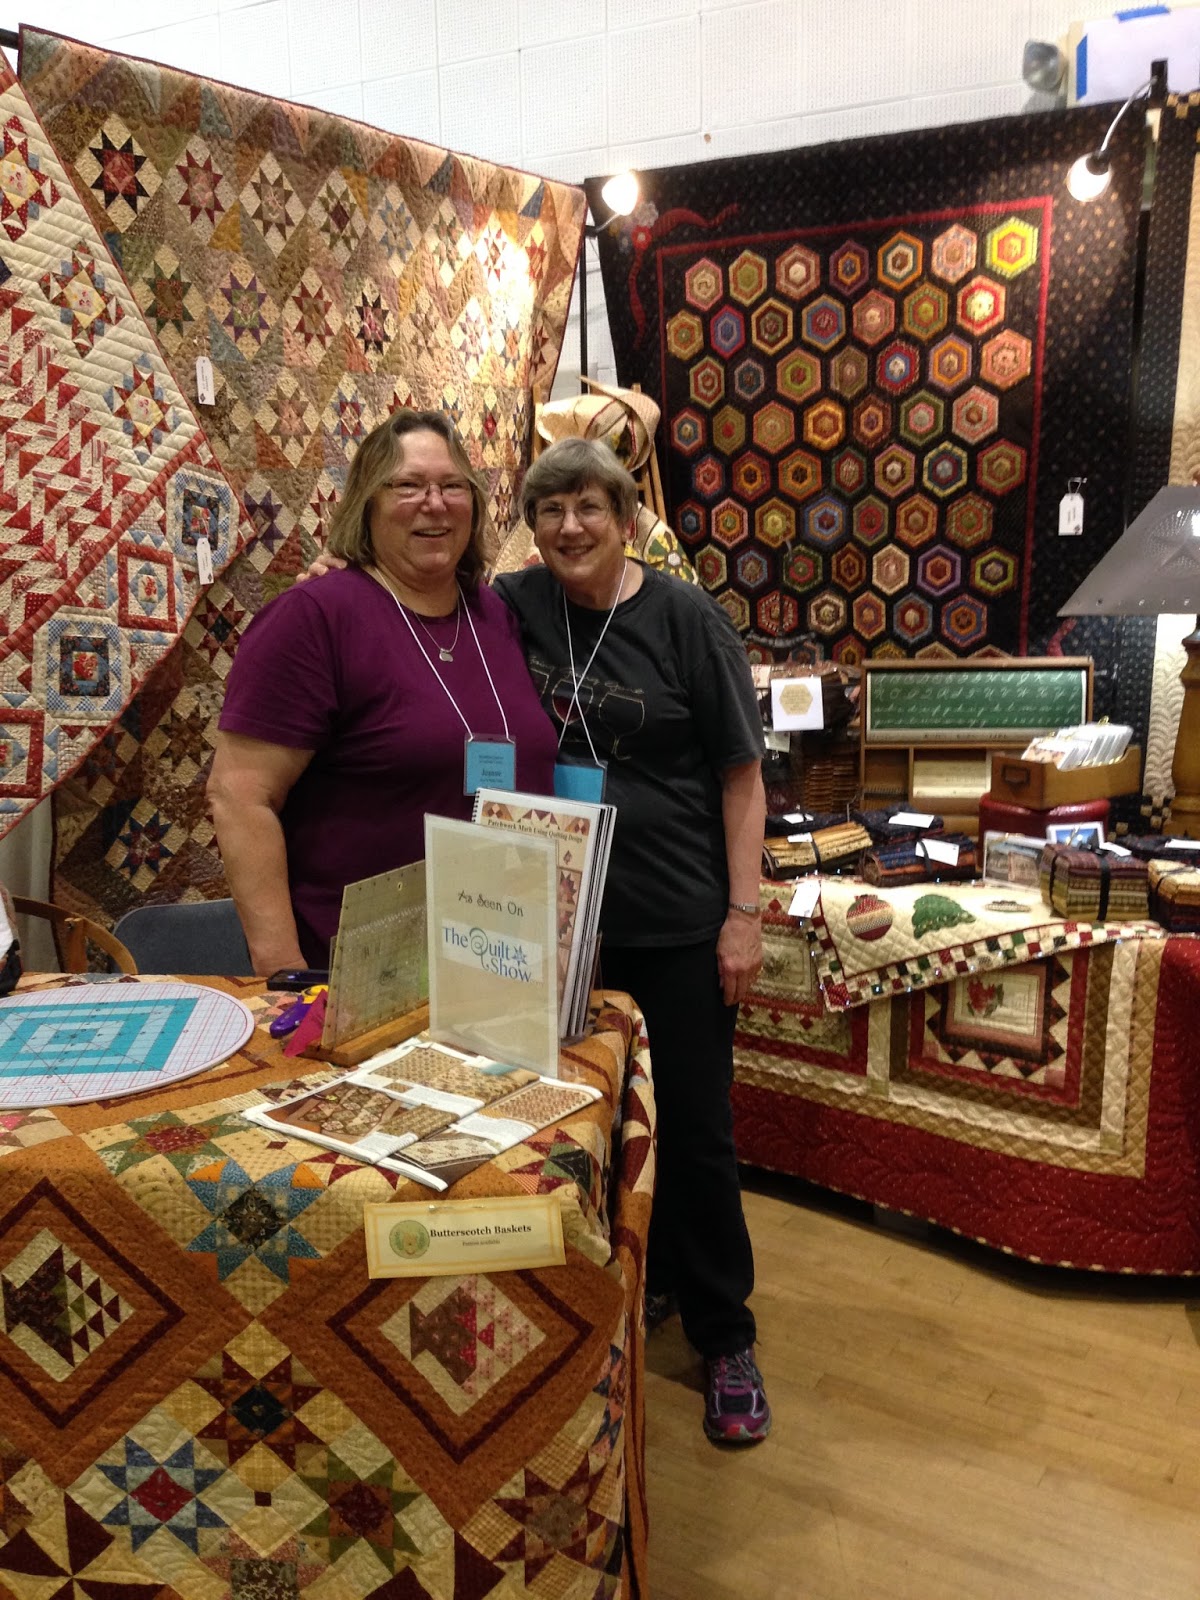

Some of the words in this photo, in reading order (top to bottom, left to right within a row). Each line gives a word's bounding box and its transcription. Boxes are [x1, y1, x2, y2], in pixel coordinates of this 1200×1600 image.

[487, 819, 516, 830] Patchwork
[518, 824, 533, 833] Math
[533, 828, 548, 837] Using
[548, 831, 568, 842] Quilting
[458, 890, 473, 904] As
[477, 893, 502, 912] Seen
[507, 901, 524, 917] On
[442, 926, 468, 948] The
[469, 926, 510, 971] Quilt
[490, 958, 532, 983] Show
[430, 1226, 491, 1237] Butterscotch
[494, 1224, 532, 1234] Baskets
